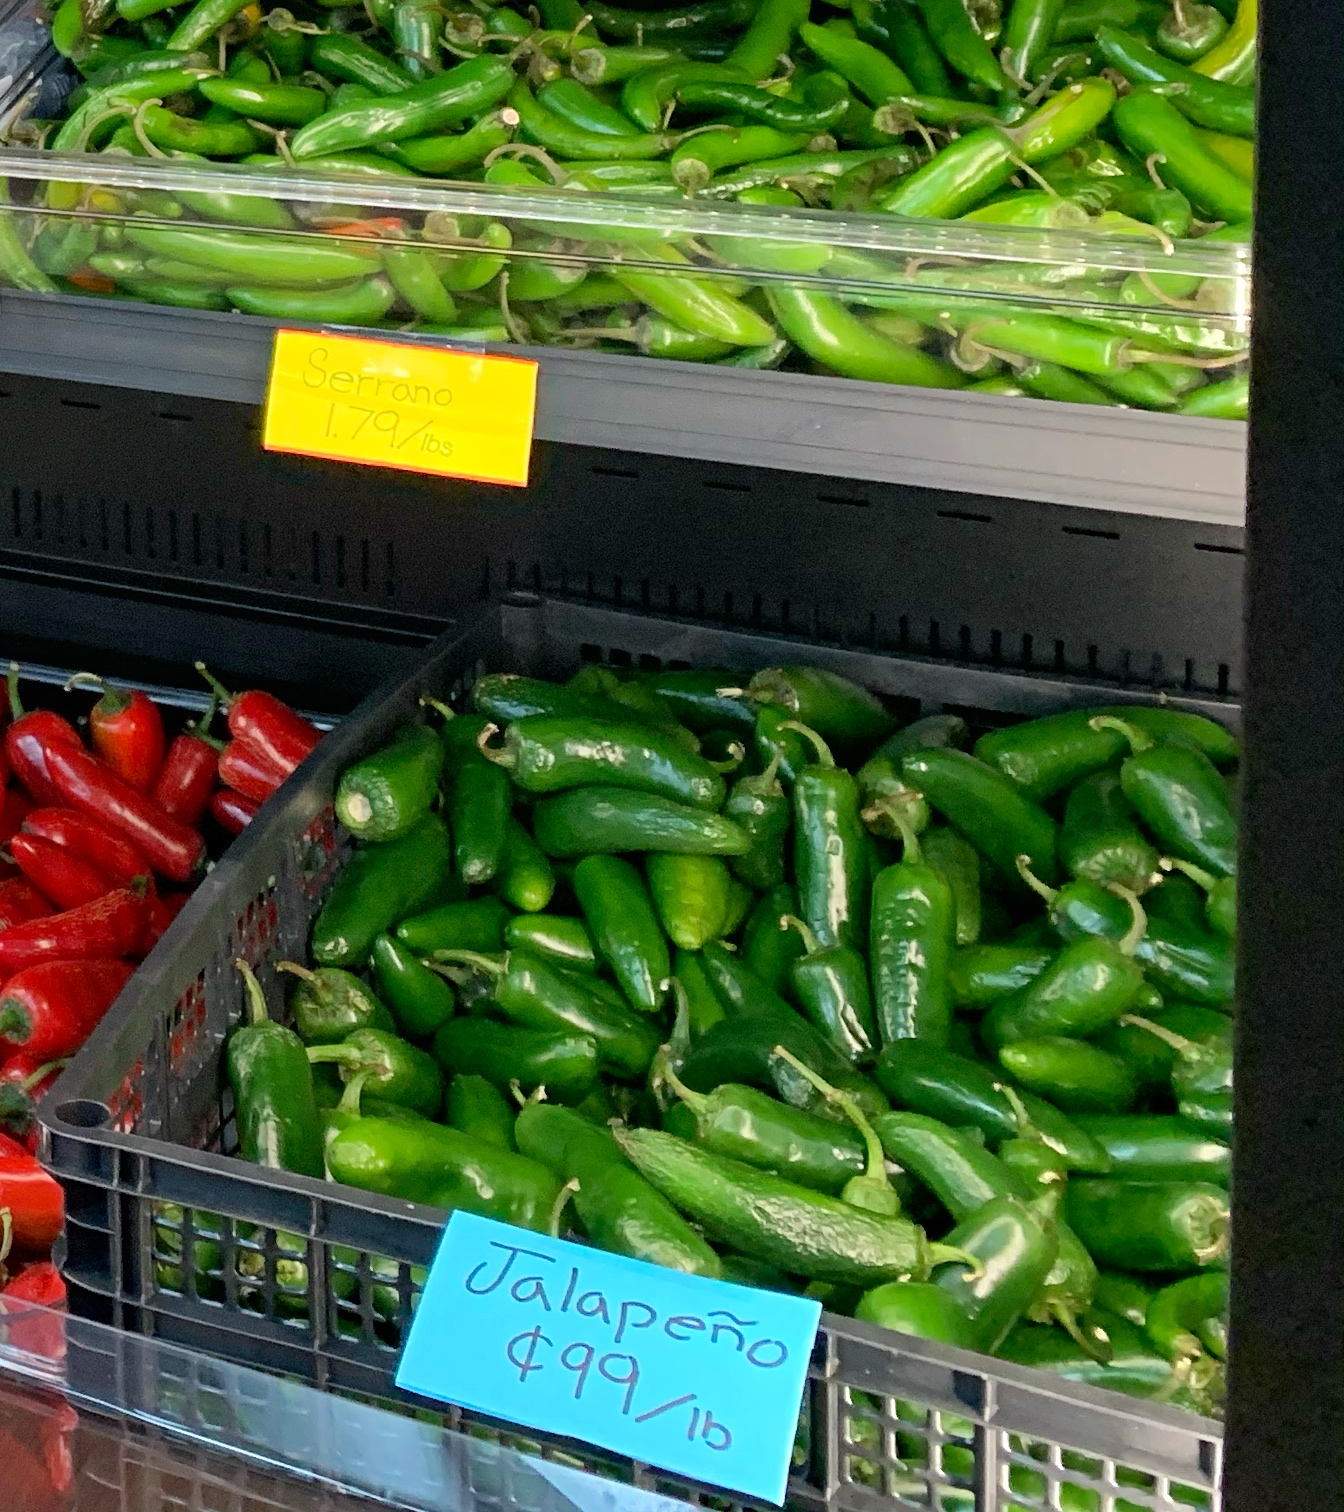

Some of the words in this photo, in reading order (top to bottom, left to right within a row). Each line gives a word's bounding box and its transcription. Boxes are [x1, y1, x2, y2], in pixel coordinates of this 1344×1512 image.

[302, 347, 453, 407] Serrano
[324, 403, 454, 458] 1.79/lbs
[465, 1240, 789, 1368] Jalapeño
[506, 1325, 733, 1451] ¢99/lb
